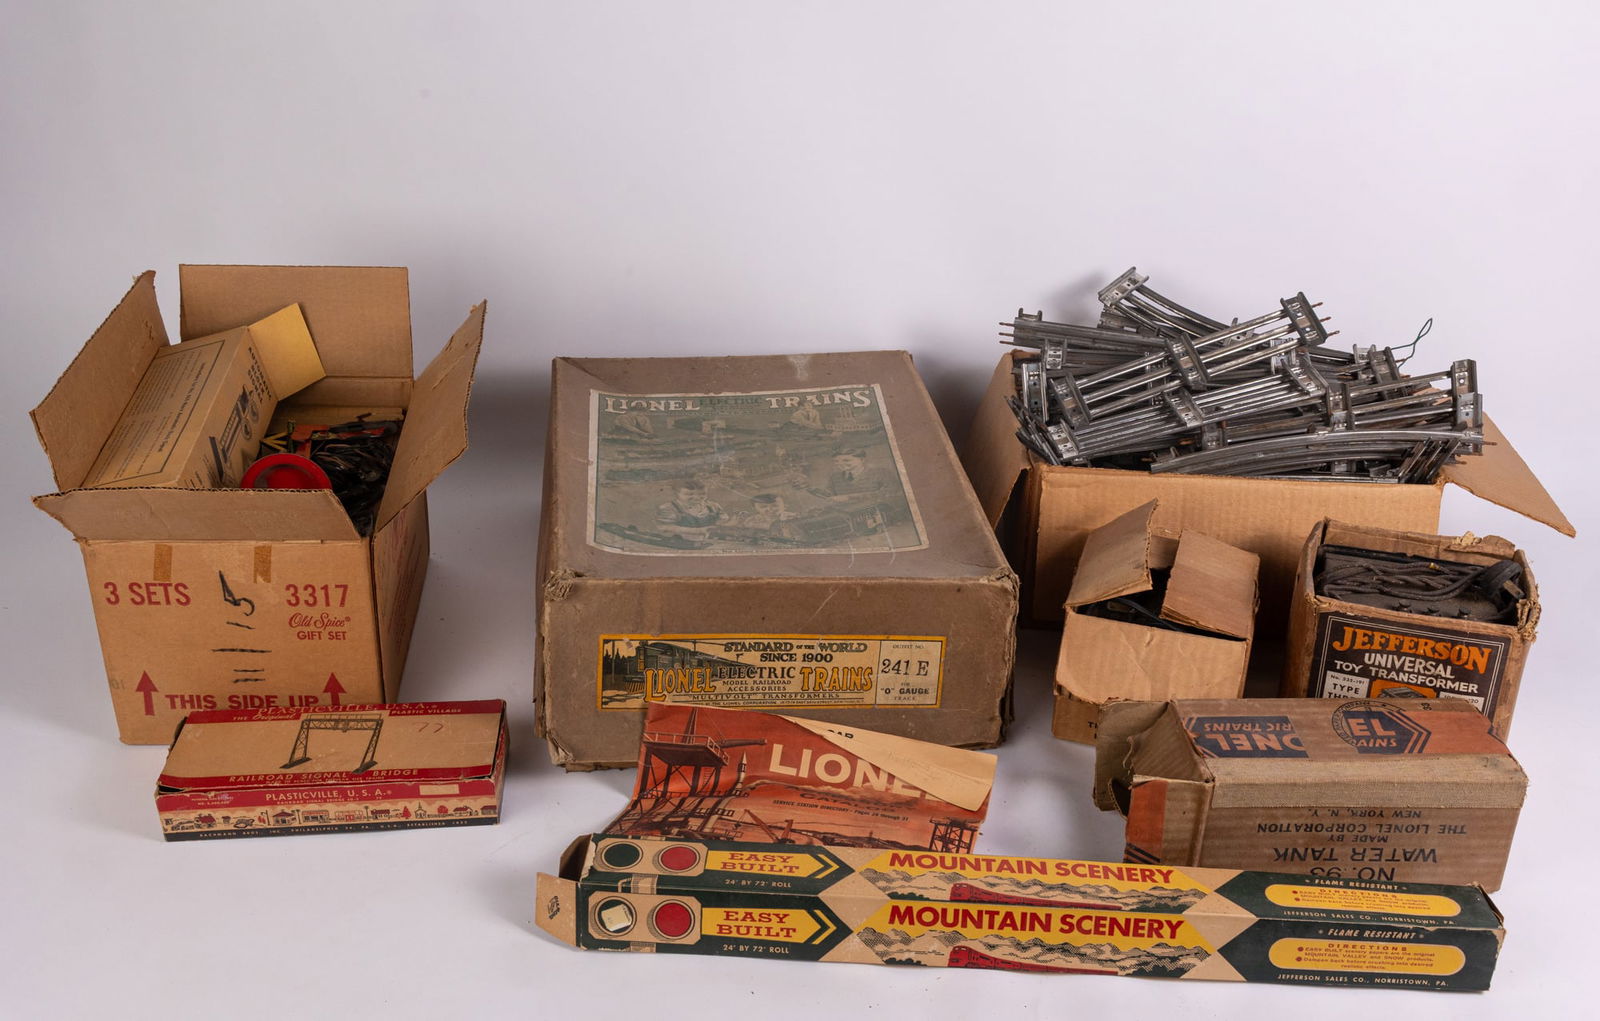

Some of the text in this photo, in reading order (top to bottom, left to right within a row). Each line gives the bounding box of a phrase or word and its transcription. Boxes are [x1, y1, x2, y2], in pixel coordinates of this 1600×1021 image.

[604, 397, 701, 414] LIONEL
[765, 389, 873, 409] TRAINS
[103, 581, 192, 607] 3 SETS
[285, 583, 349, 608] 3317
[288, 612, 314, 629] Old
[296, 630, 347, 641] GIFT SET
[724, 641, 794, 653] STANDARD
[817, 641, 868, 653] WORLD
[1332, 626, 1493, 674] JEFFERSON
[760, 652, 834, 663] SINCE 1900
[880, 658, 930, 677] 241 E
[1364, 652, 1456, 679] UNIVERSAL
[1334, 659, 1479, 694] TOY TRANSFORMER
[642, 665, 874, 703] LIONEL ELECTRIC TRAINS
[1332, 682, 1361, 695] TYPE
[898, 687, 930, 695] GAUGE
[165, 694, 320, 710] THIS SIDE UP
[258, 702, 377, 715] PLASTICVILLE,
[251, 712, 297, 721] Original
[1203, 722, 1263, 732] TRAINS
[1346, 718, 1396, 737] EL
[229, 774, 294, 783] RAILROAD
[301, 771, 348, 780] SIGNAL
[372, 769, 419, 777] BRIDGE
[769, 743, 942, 801] LIONE
[265, 789, 342, 801] PLASTICVILLE,
[772, 799, 795, 807] SERVICE
[820, 804, 849, 812] DIRECTORY
[1348, 807, 1385, 818] YORK,
[1392, 810, 1422, 818] NEW
[1257, 822, 1467, 835] THE LIONEL CORPORATION
[1327, 834, 1389, 844] MADE BY
[727, 852, 794, 864] EASY
[1273, 846, 1438, 864] WATER TANK
[720, 861, 800, 874] BUILT
[888, 852, 1174, 884] MOUNTAIN SCENERY
[1310, 866, 1395, 881] NO. 93
[1315, 879, 1399, 891] FLAME RESISTANT
[723, 910, 790, 924] EASY
[887, 904, 1185, 940] MOUNTAIN SCENERY
[1283, 910, 1327, 918] JEFFERSON
[1330, 912, 1355, 920] SALES
[1381, 916, 1440, 925] NORRISTOWN,
[716, 923, 797, 938] BUILT
[1327, 928, 1417, 940] FLAME RESISTANT
[739, 944, 750, 952] BY
[769, 946, 790, 954] ROLL
[1327, 943, 1408, 952] DIRECTIONS
[1277, 973, 1321, 981] JEFFERSON
[1324, 975, 1348, 983] SALES
[1374, 977, 1431, 986] NORRISTOWN,
